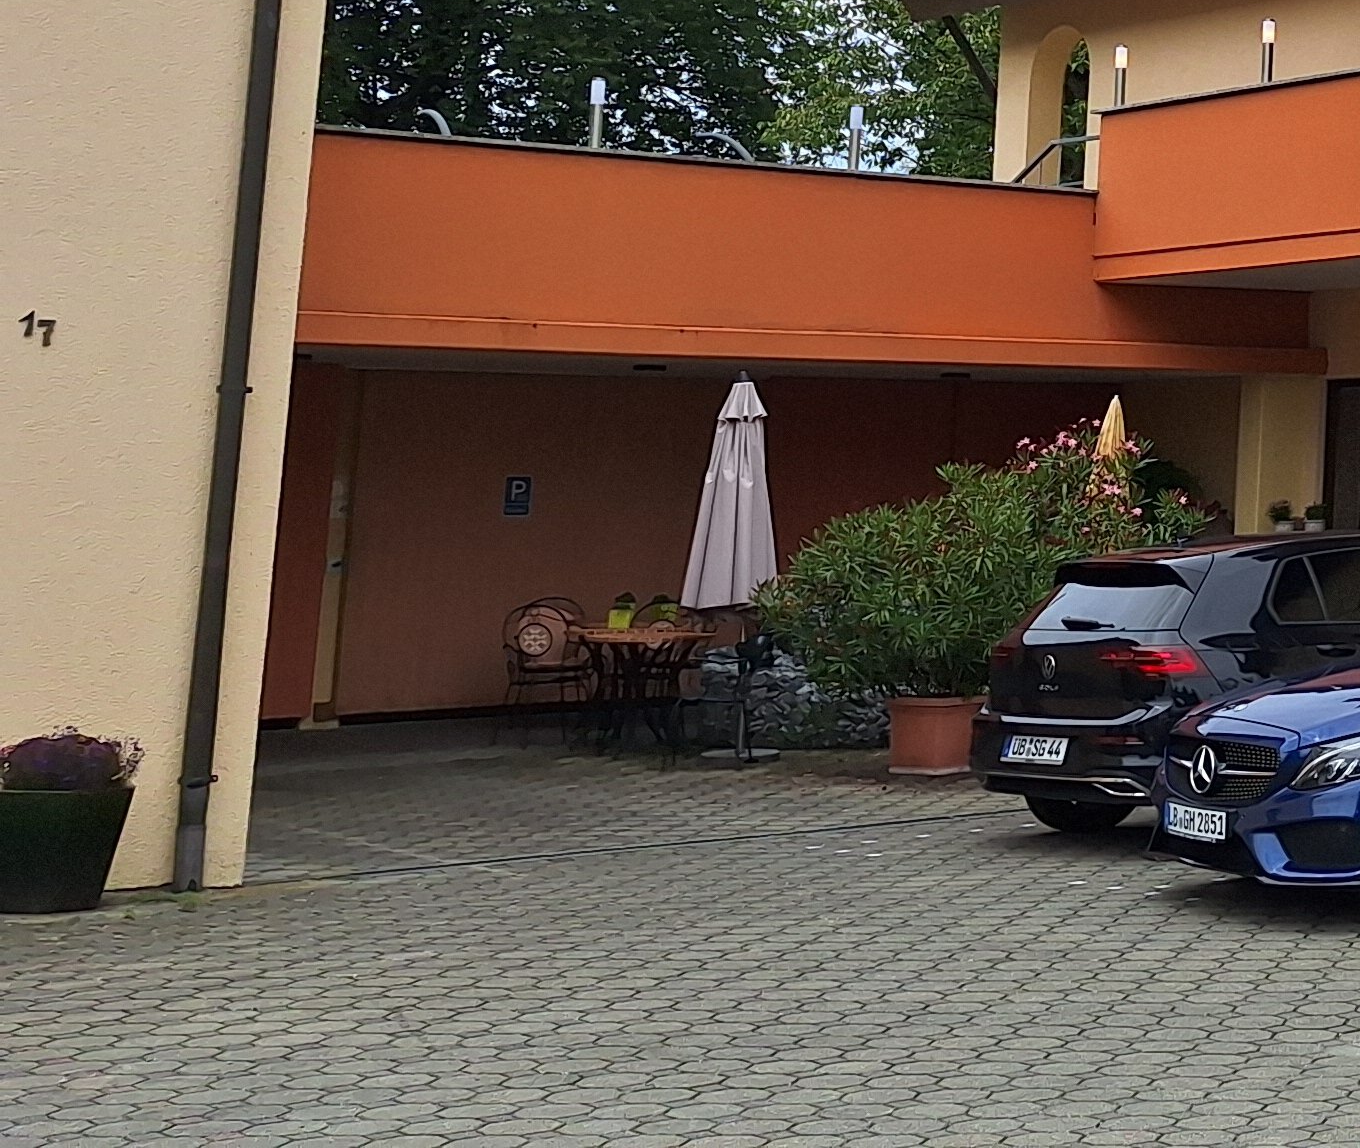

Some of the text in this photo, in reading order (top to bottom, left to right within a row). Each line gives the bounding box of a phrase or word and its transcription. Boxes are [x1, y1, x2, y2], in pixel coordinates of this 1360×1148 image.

[17, 310, 57, 347] 17
[511, 480, 527, 502] P
[1012, 738, 1028, 756] ÜB
[1031, 738, 1048, 757] SG
[1047, 739, 1063, 759] 44
[1183, 809, 1196, 832] GH
[1197, 811, 1224, 836] 2851
